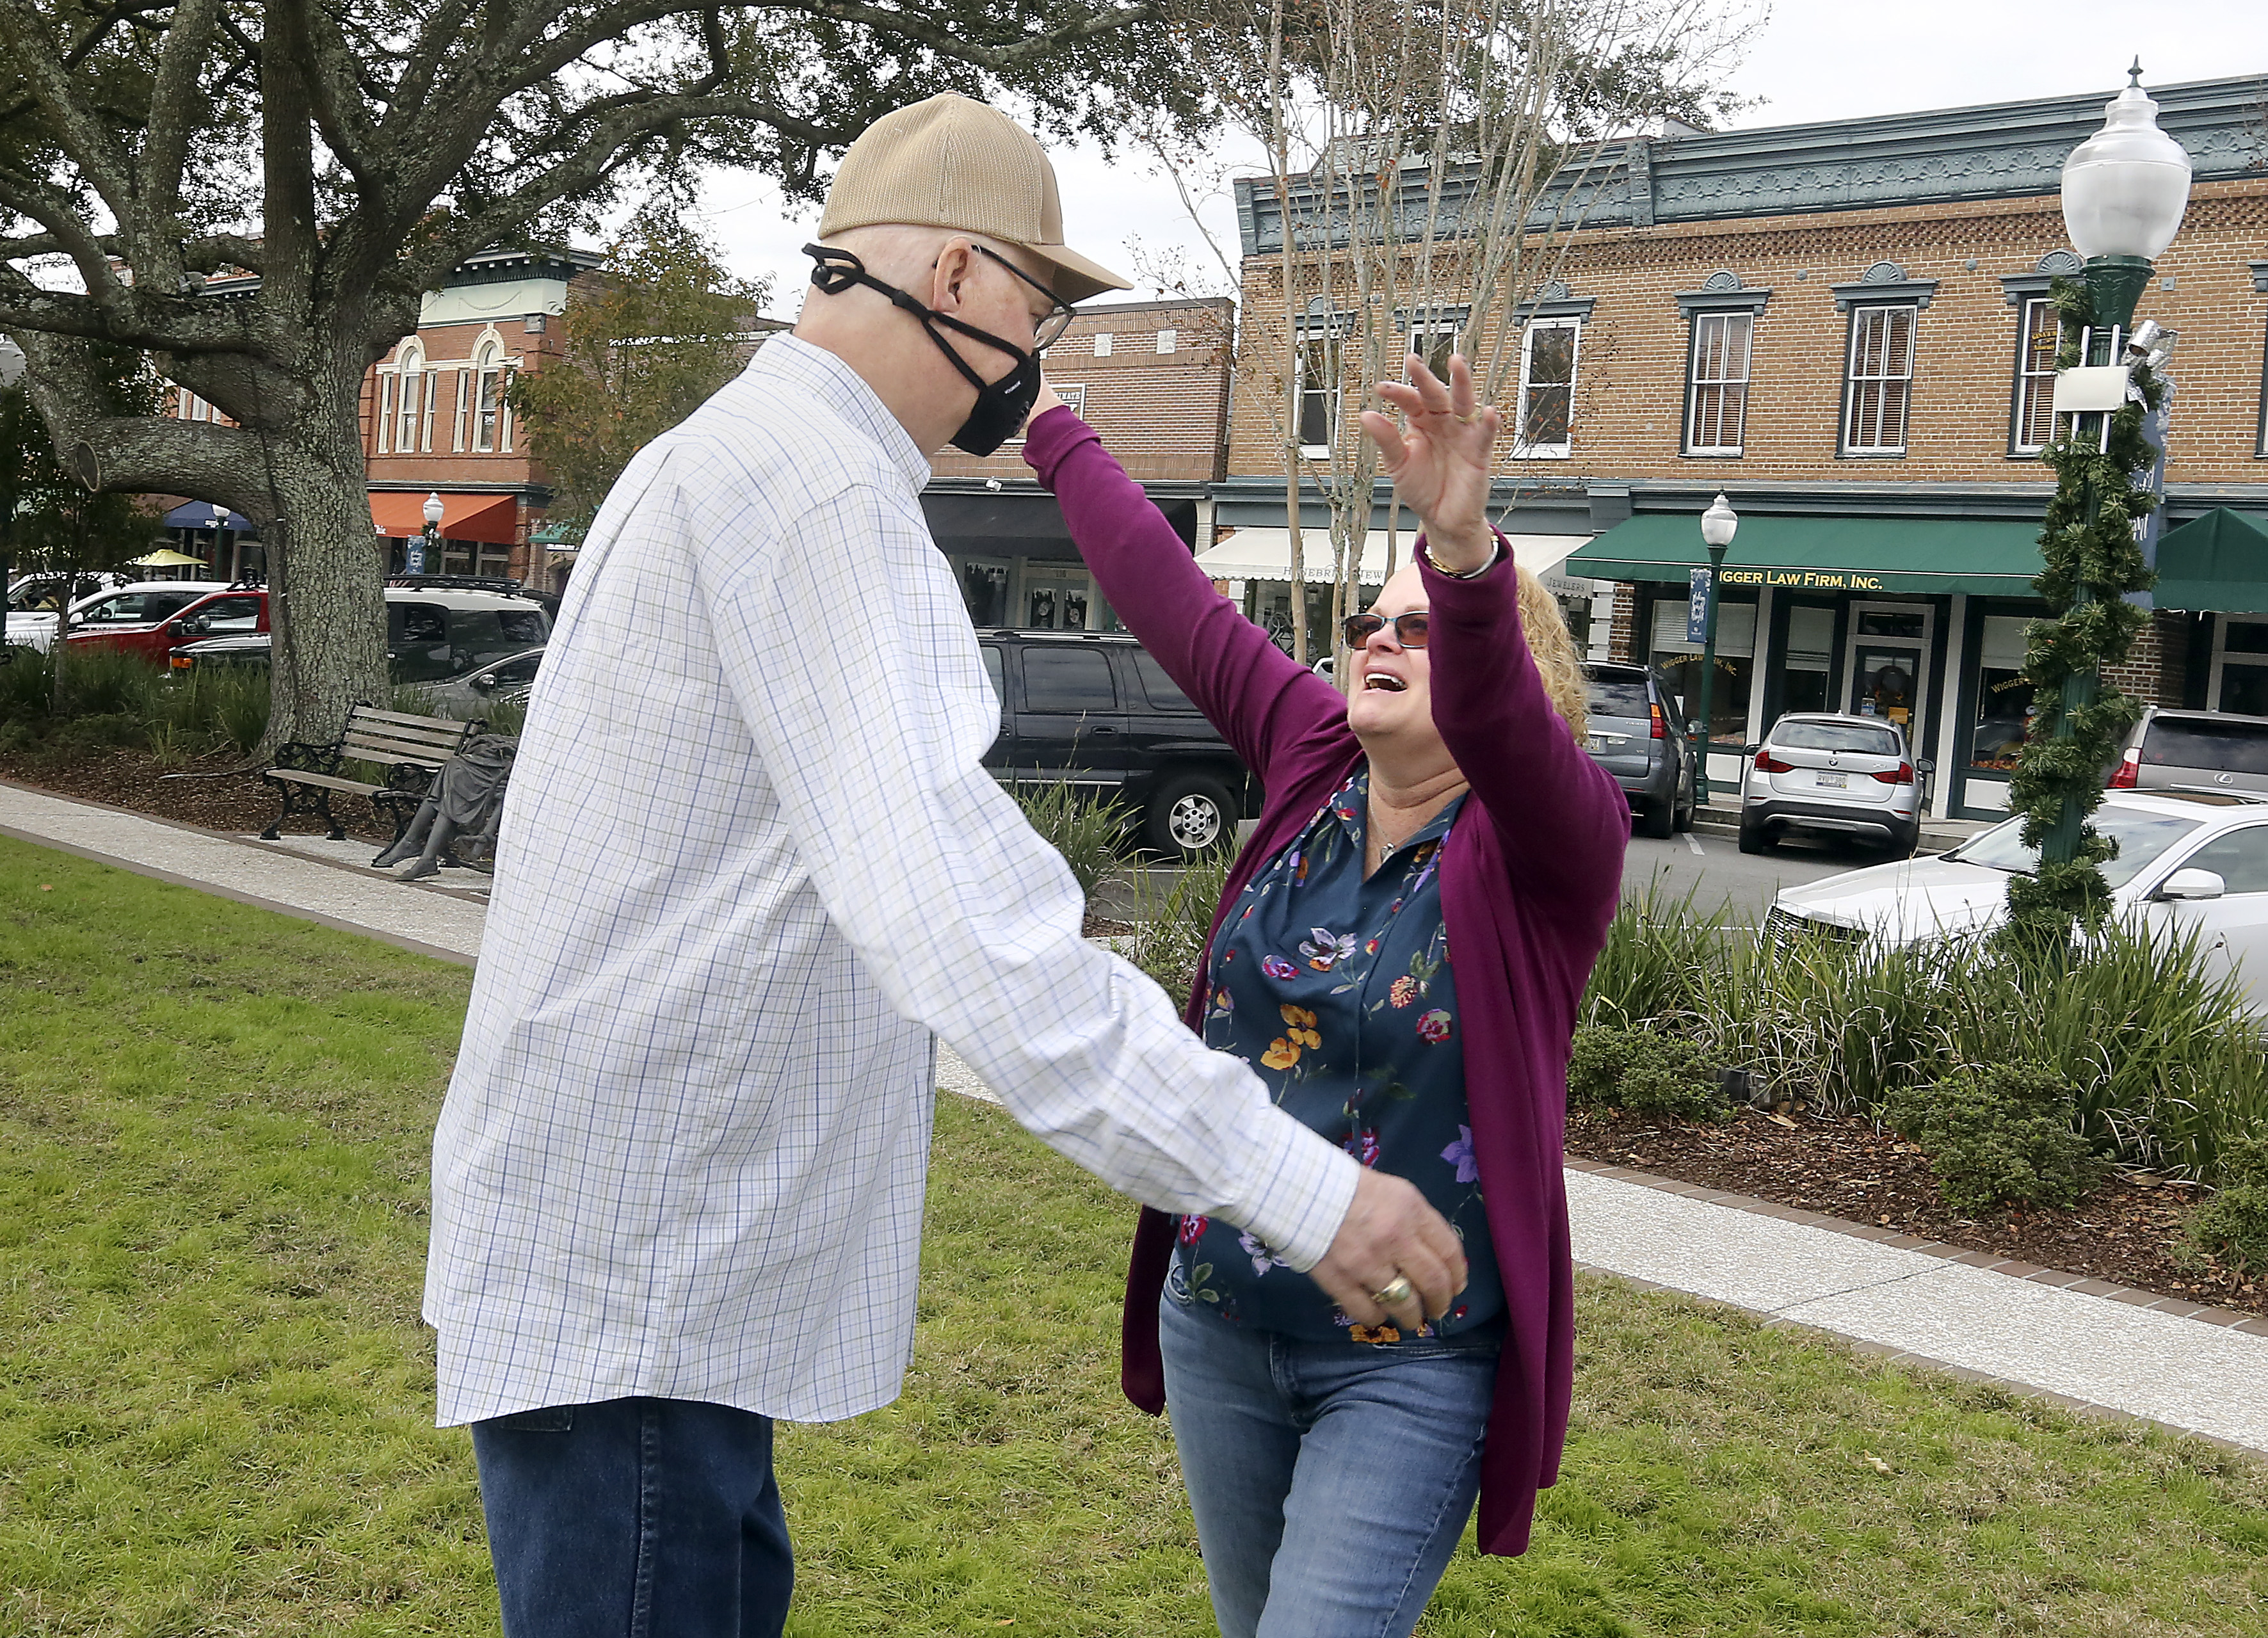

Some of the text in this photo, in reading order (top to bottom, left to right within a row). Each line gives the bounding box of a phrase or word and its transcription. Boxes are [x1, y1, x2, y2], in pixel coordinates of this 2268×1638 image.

[1054, 392, 1081, 400] IMATE
[1719, 570, 1763, 584] IGGER
[1547, 577, 1585, 592] JEWELERS
[1661, 655, 1688, 670] WIGGER
